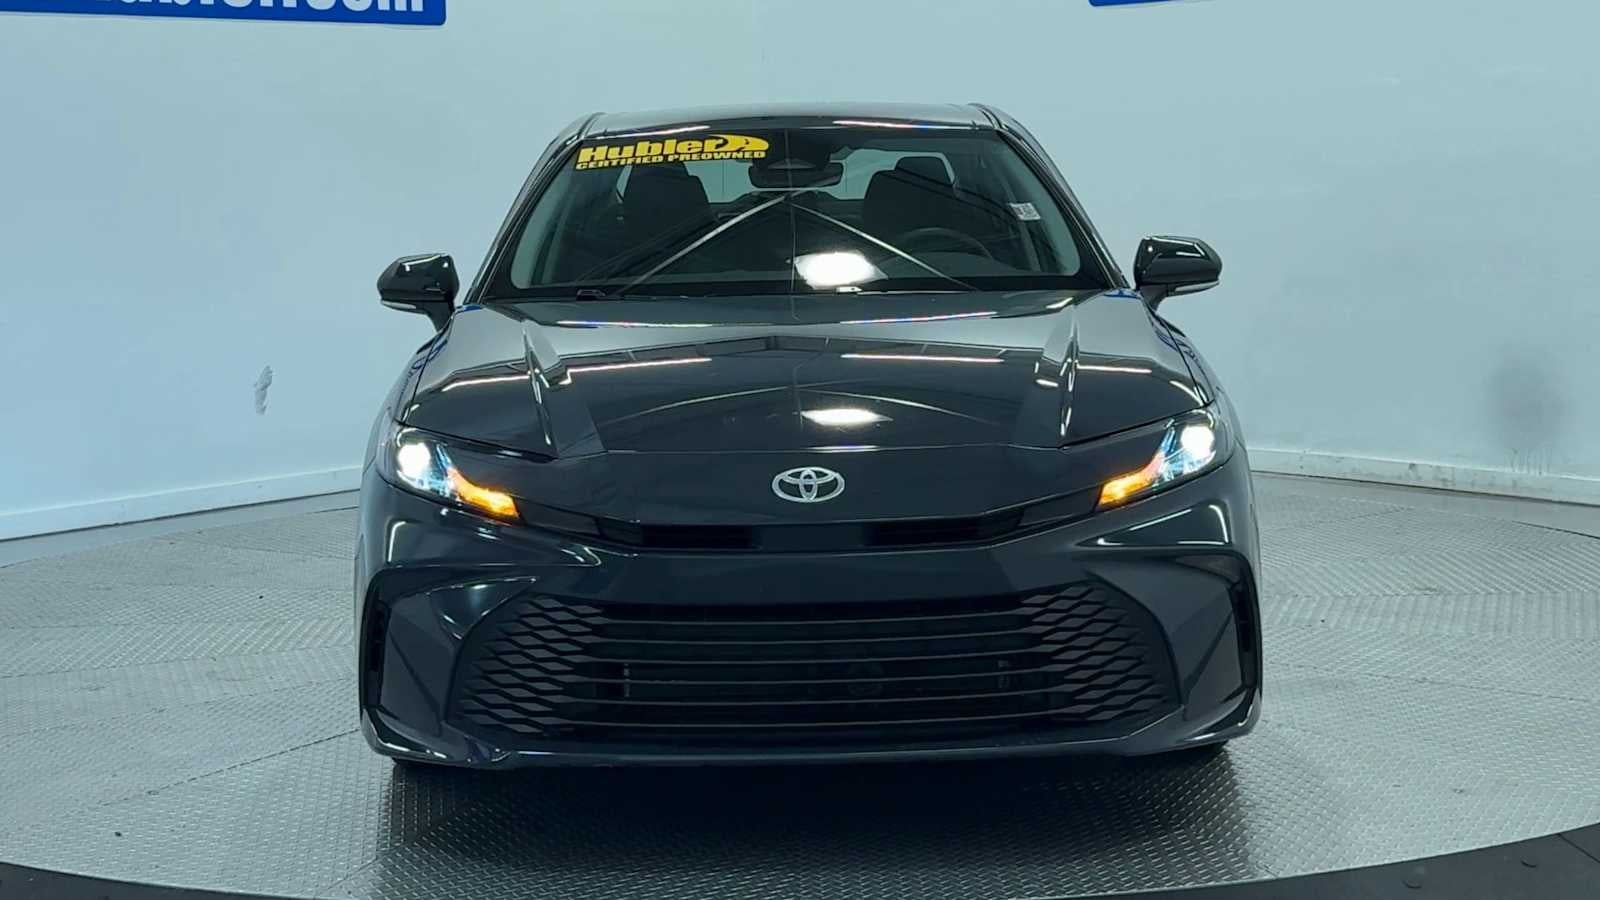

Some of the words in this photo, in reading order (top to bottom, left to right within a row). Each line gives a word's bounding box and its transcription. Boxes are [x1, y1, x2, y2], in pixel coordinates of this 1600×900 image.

[575, 155, 664, 170] CERTIFIED
[667, 151, 766, 162] PREOWNED
[577, 139, 726, 162] Hubler
